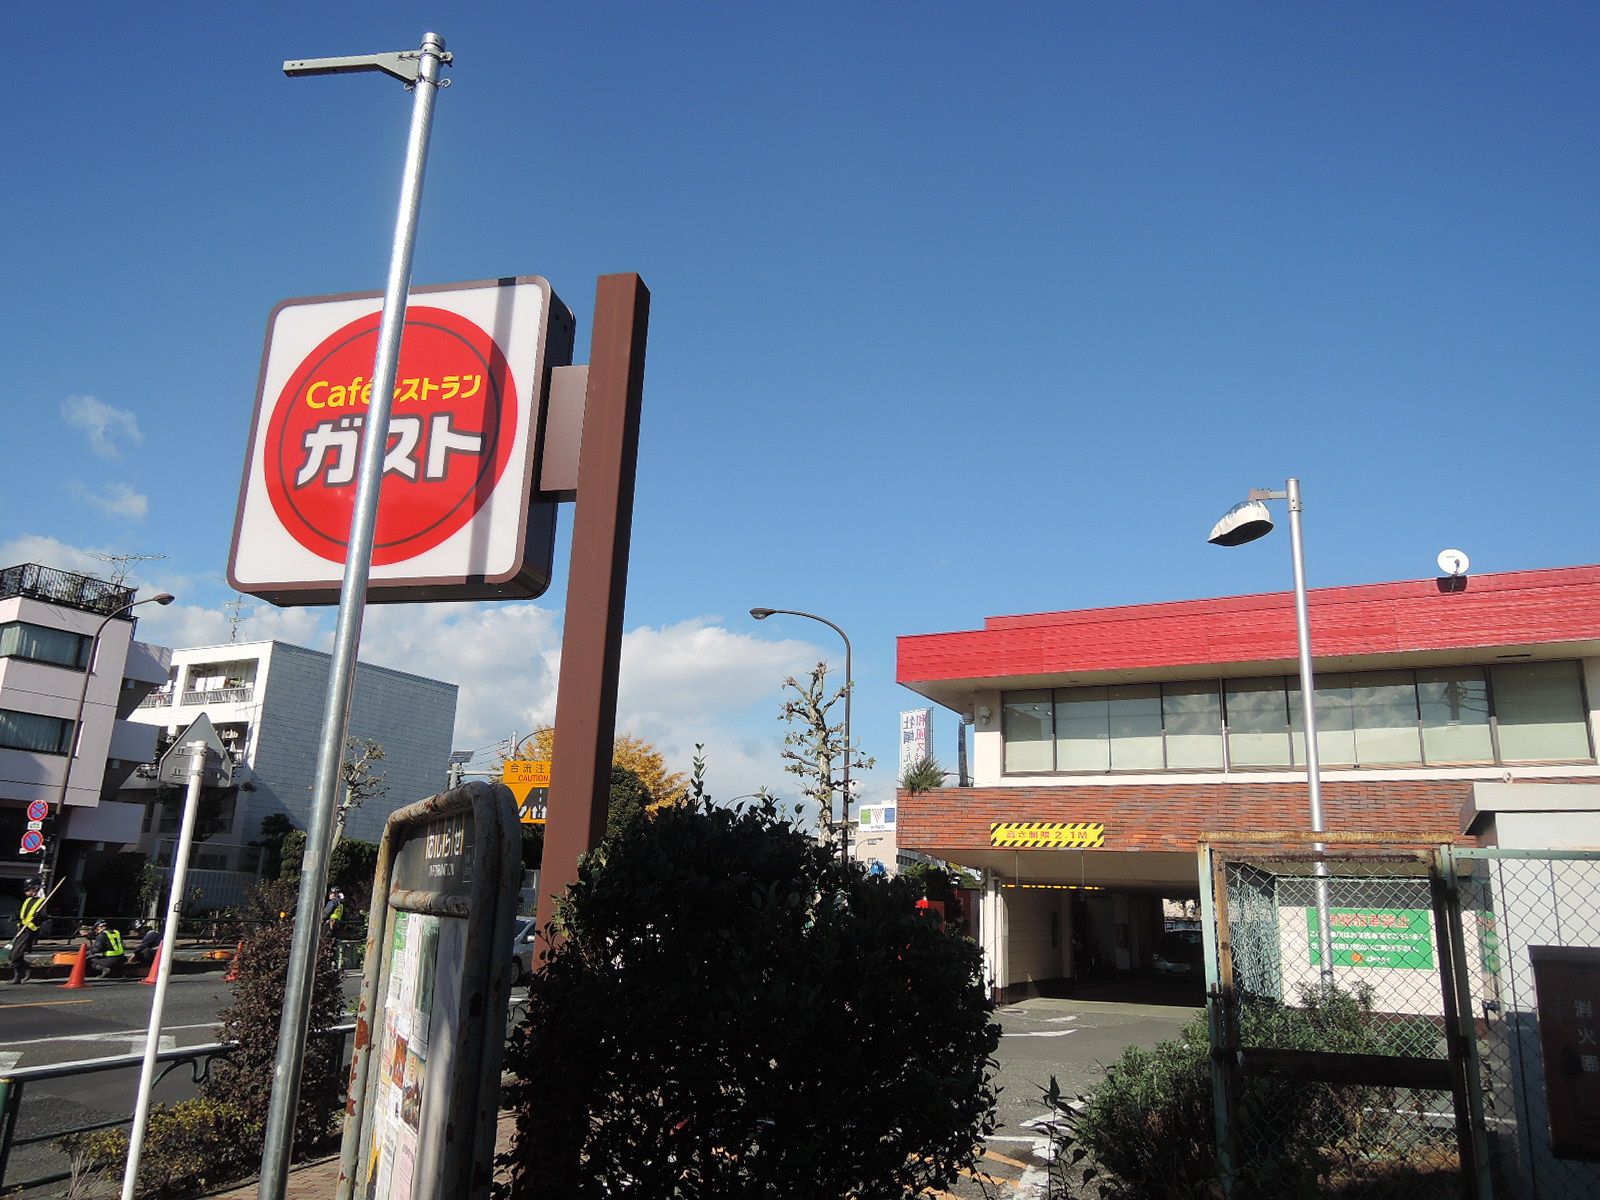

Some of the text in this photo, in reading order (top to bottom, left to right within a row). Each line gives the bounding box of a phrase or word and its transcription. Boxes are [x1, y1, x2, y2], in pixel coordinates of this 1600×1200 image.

[395, 374, 482, 403] ストラン
[296, 413, 485, 488] ガスト
[510, 763, 551, 774] 合流注
[518, 774, 549, 783] CAUTION
[1573, 999, 1599, 1068] 消火器
